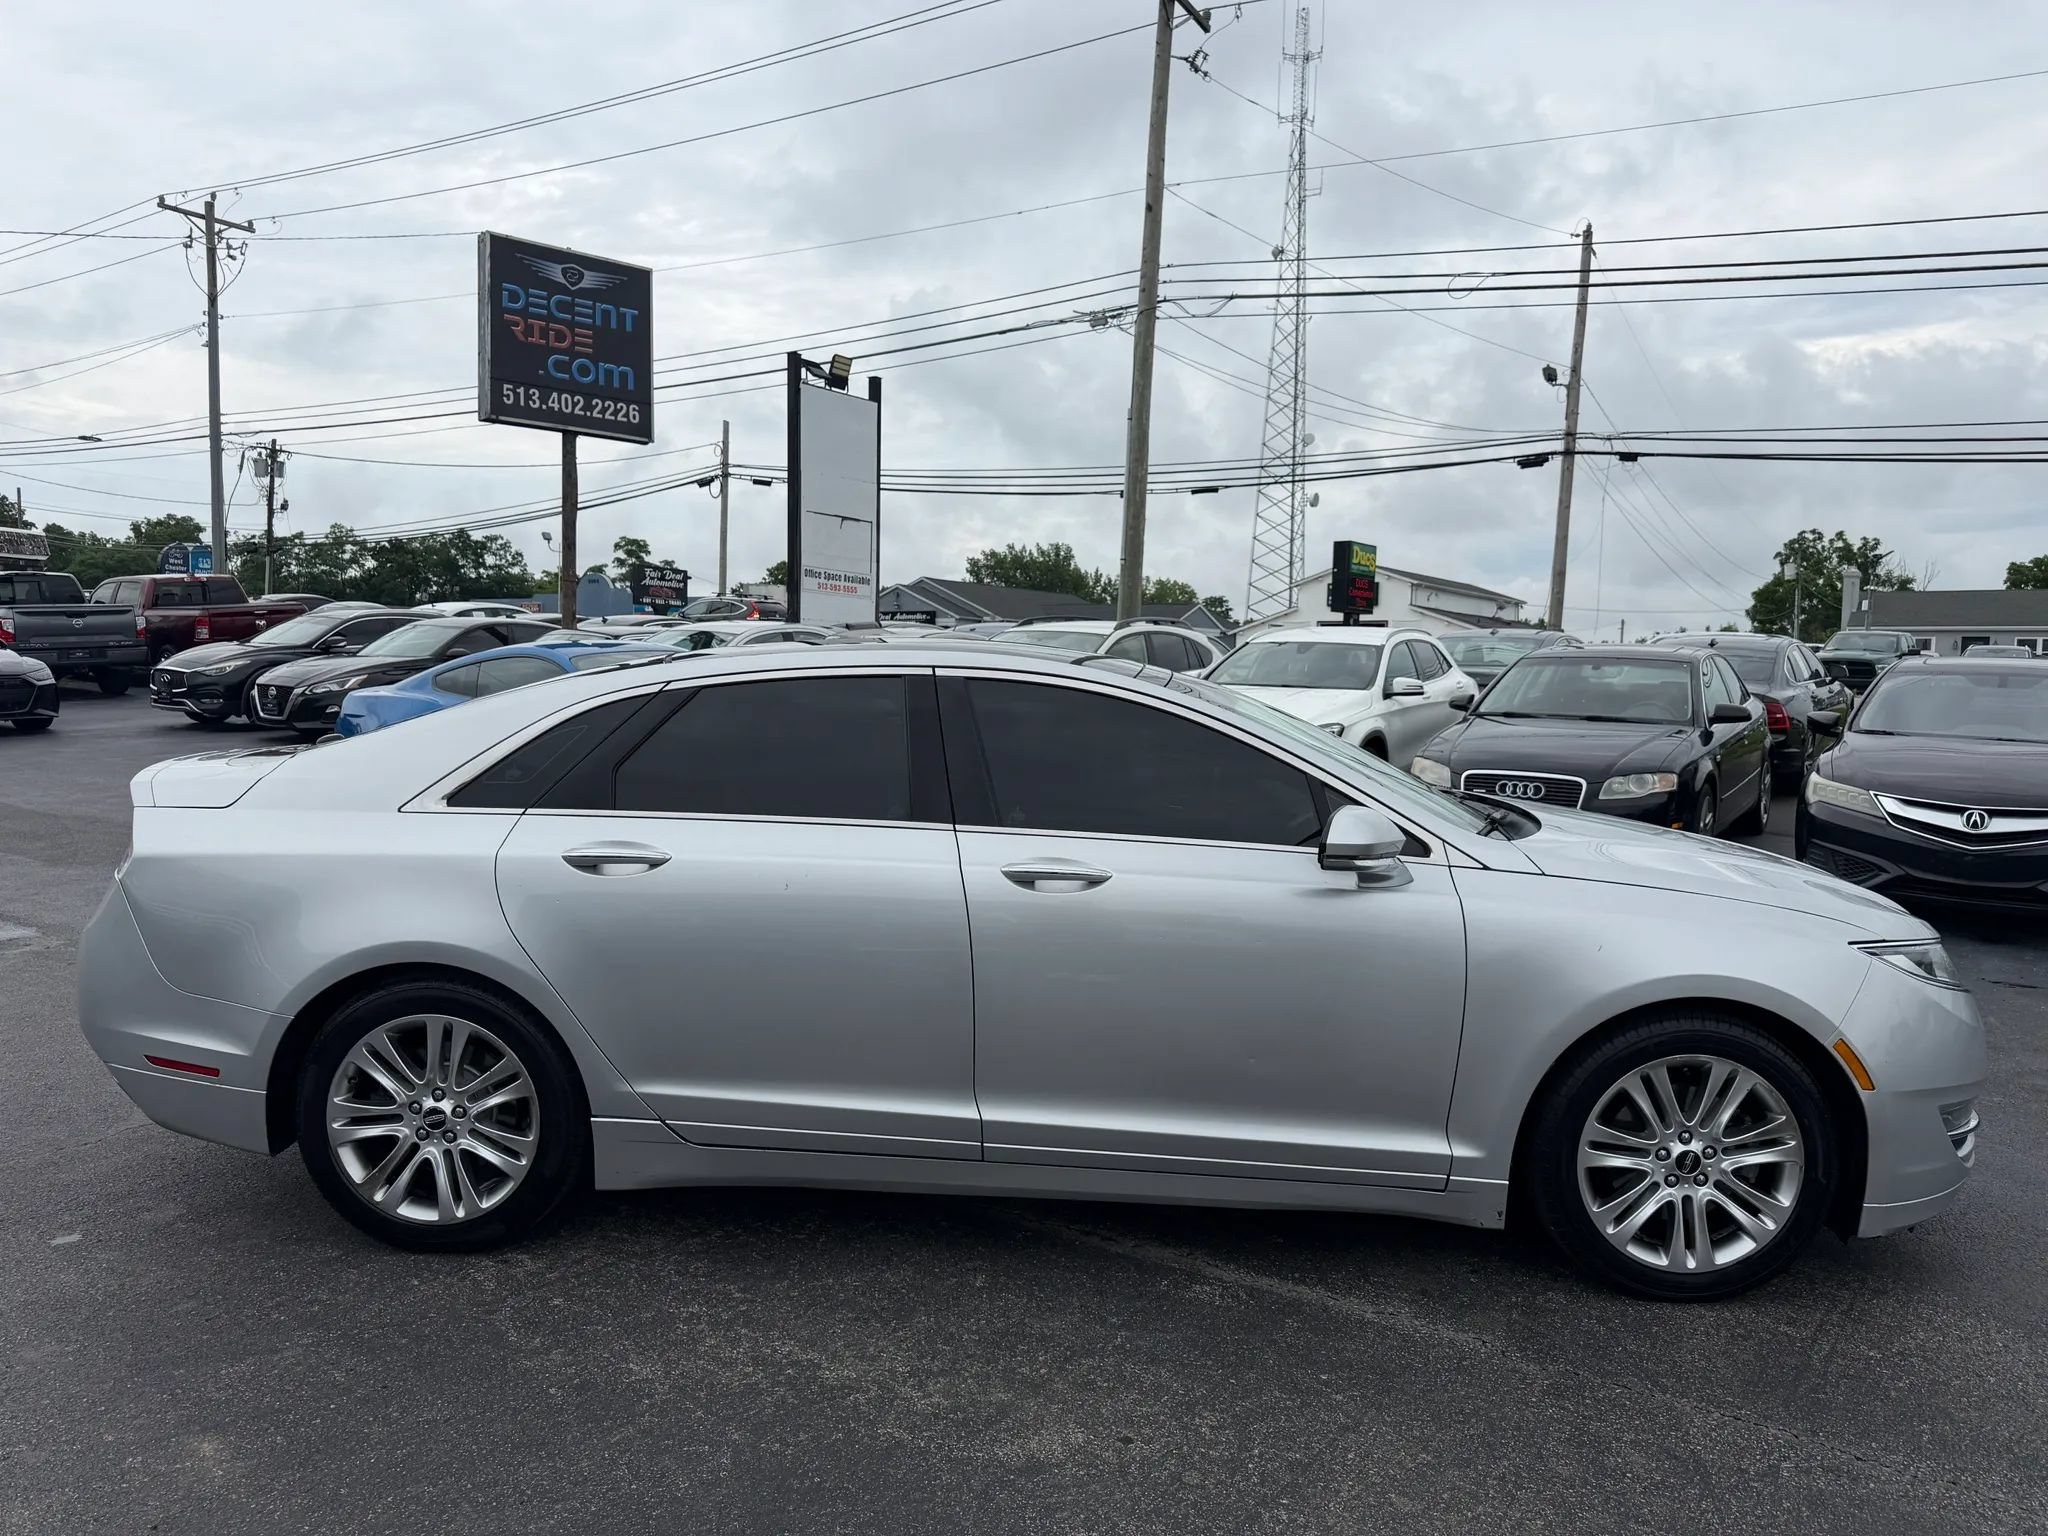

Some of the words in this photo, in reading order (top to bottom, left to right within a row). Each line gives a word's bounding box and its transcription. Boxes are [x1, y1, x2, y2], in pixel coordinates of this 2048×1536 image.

[504, 313, 593, 354] RIDE
[502, 383, 640, 424] 513.402.2226
[164, 563, 187, 572] Chester
[644, 568, 661, 578] Fair
[663, 570, 684, 581] Deal
[641, 577, 685, 589] Automotive
[804, 568, 822, 580] Office
[823, 571, 842, 583] Space
[843, 574, 871, 586] Available
